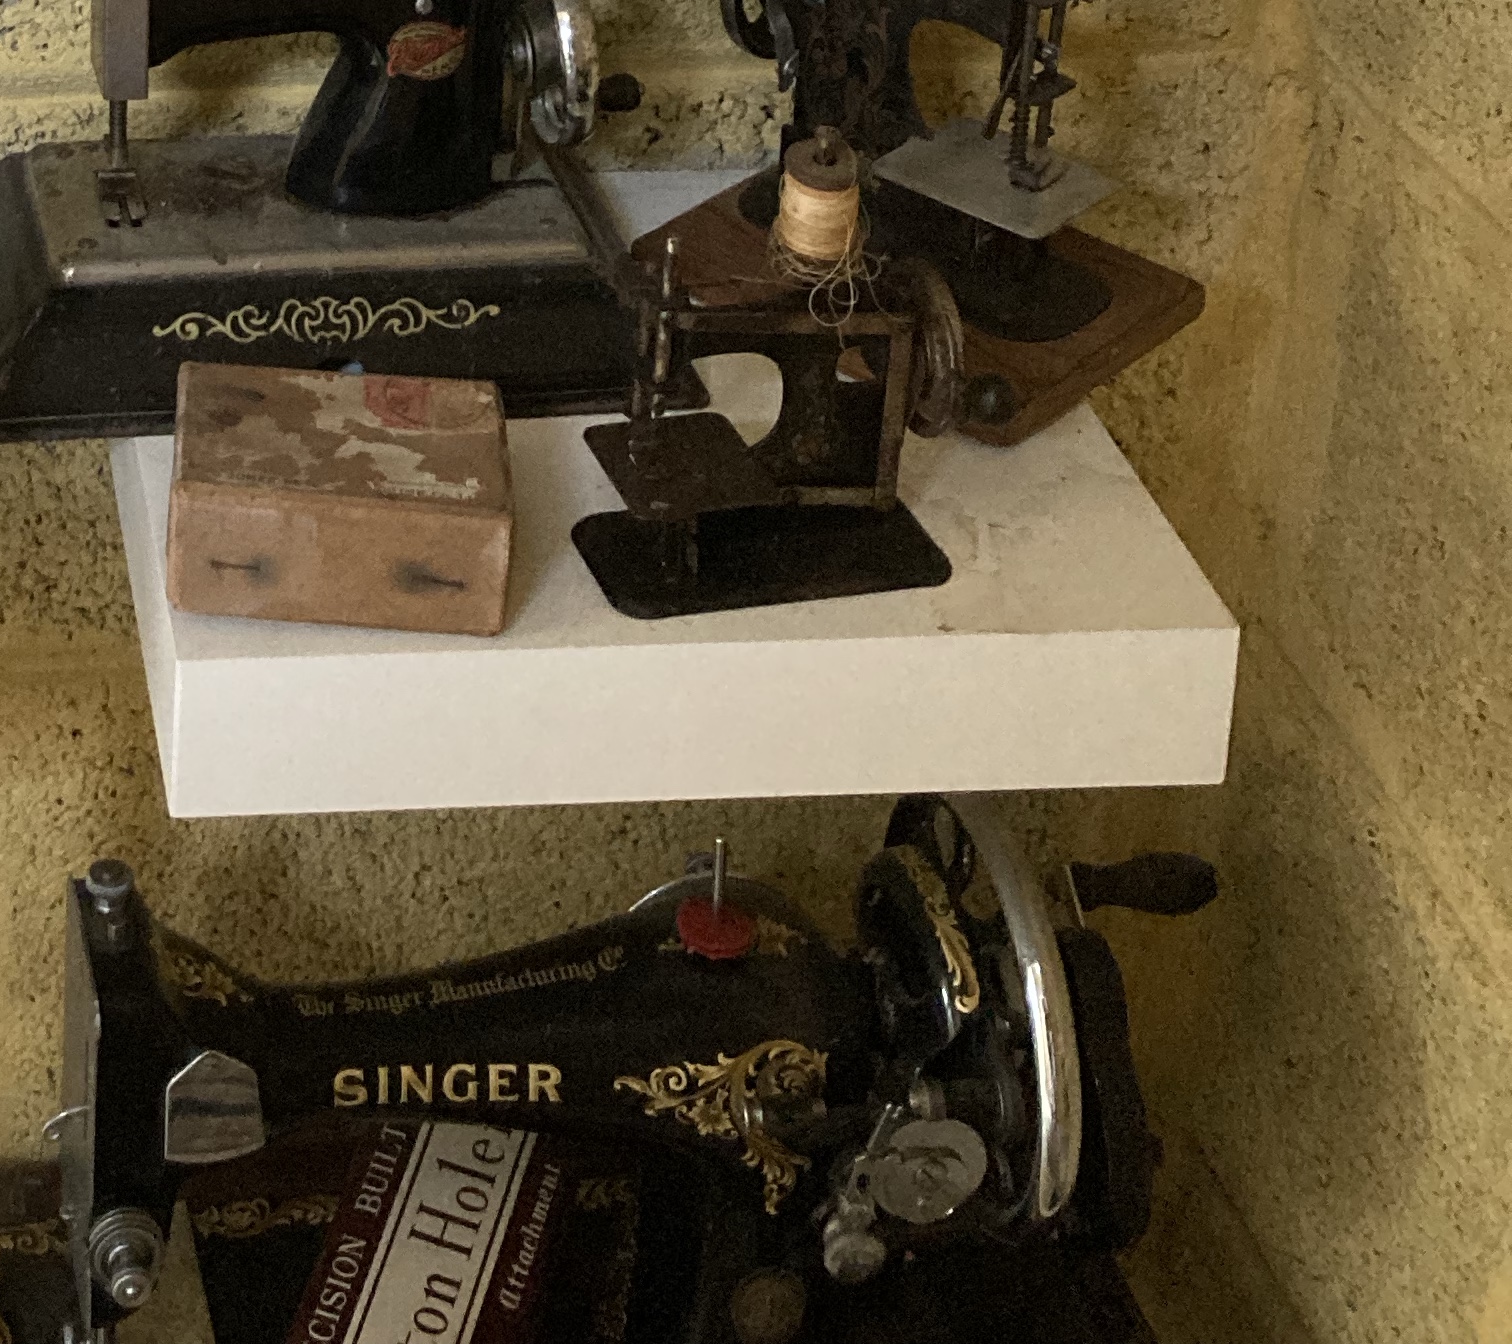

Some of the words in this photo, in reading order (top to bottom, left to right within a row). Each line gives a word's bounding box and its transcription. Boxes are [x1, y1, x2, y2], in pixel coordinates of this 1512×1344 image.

[344, 990, 424, 1015] Singer
[430, 959, 597, 1008] Manufacturing
[333, 1063, 563, 1108] SINGER
[305, 1232, 368, 1344] CISION
[353, 1125, 407, 1215] BUILT
[498, 1162, 561, 1310] Attachment
[398, 1272, 463, 1344] on
